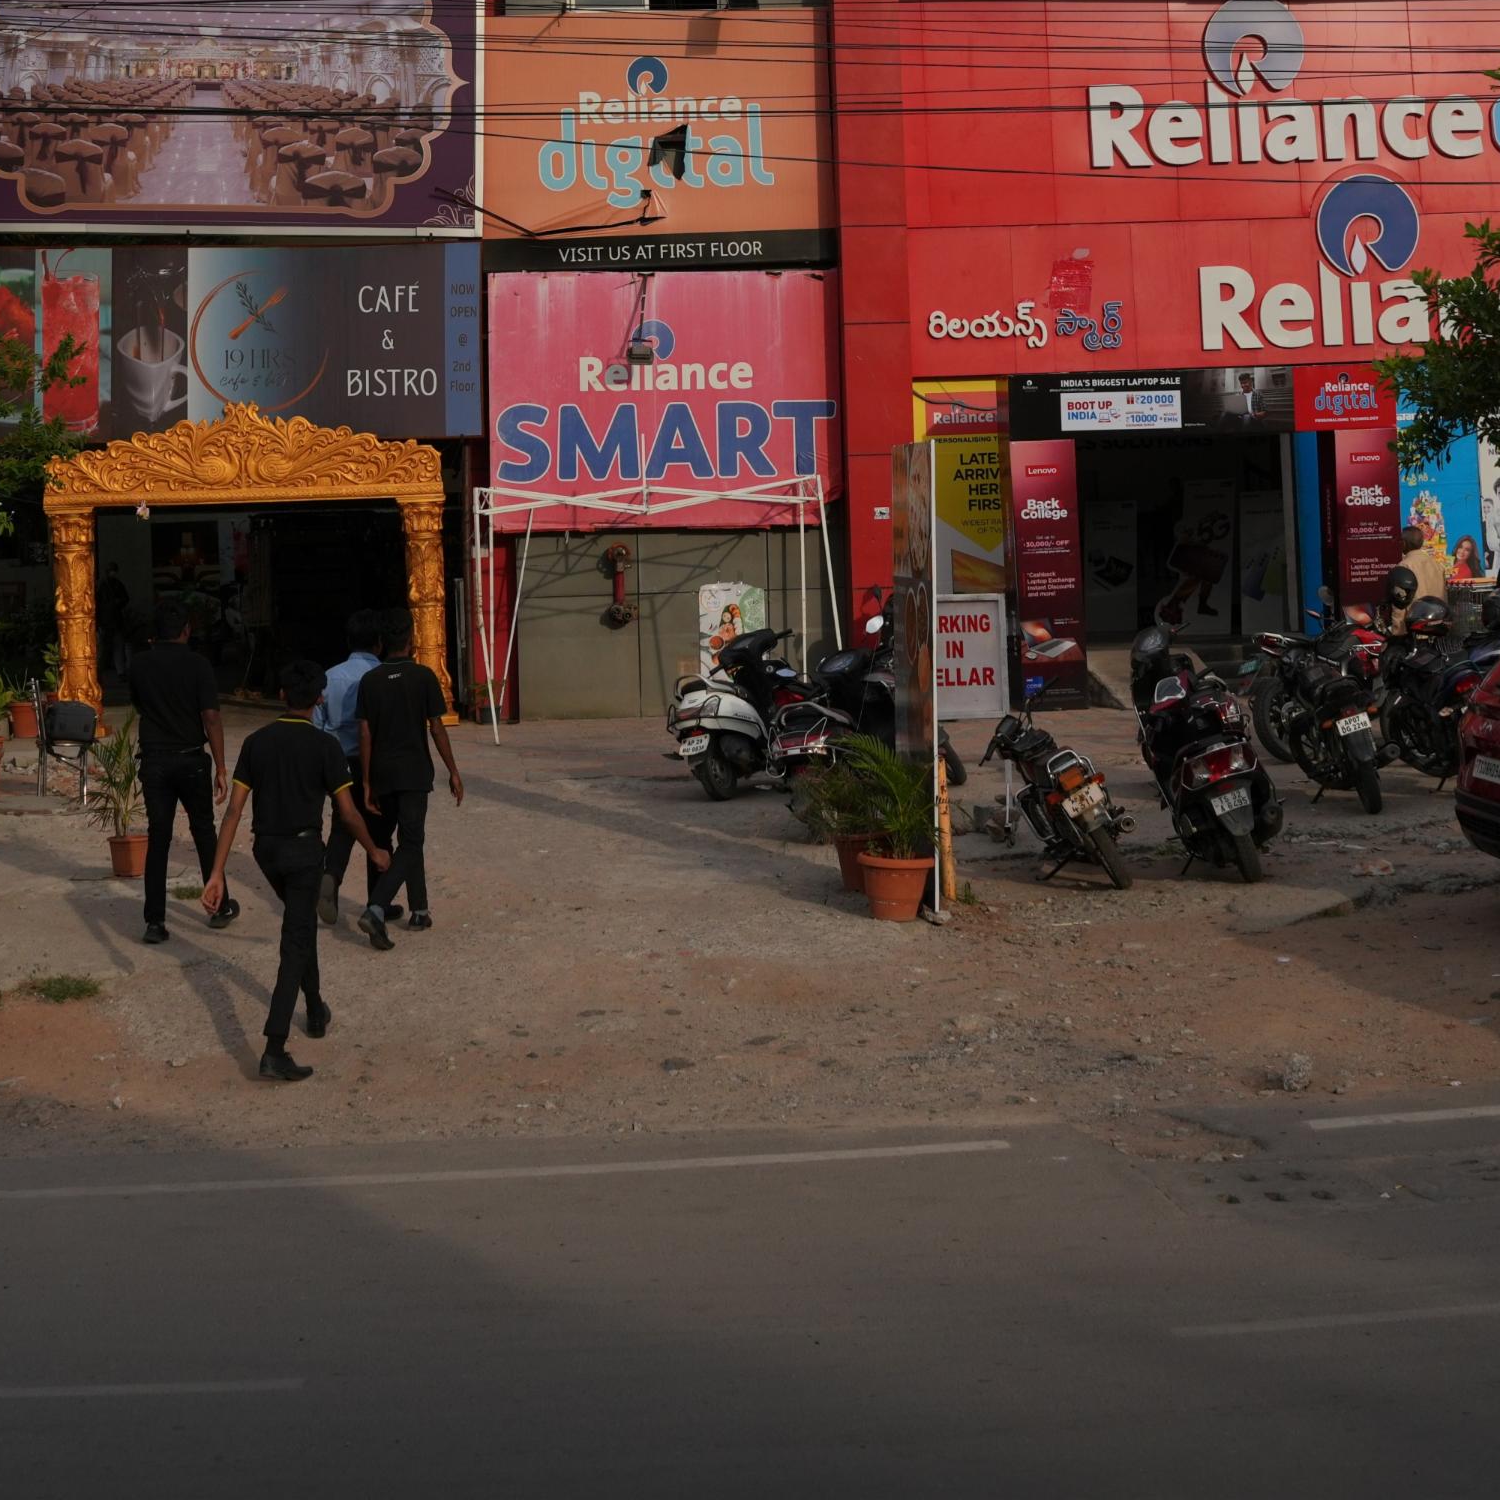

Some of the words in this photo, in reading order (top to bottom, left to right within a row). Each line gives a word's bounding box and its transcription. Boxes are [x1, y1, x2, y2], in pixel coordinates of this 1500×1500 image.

[578, 90, 744, 124] Reliance
[1086, 79, 1483, 169] Reliance
[558, 246, 604, 263] VISIT
[607, 245, 629, 261] US
[631, 244, 654, 260] AT
[660, 243, 705, 259] FIRST
[711, 240, 763, 257] FLOOR
[450, 283, 475, 295] NOW
[357, 281, 420, 313] CAFÉ
[450, 306, 478, 318] OPEN
[928, 301, 1048, 349] రిలయన్స్
[1055, 301, 1123, 351] స్మార్ట్
[381, 329, 395, 350] &
[458, 333, 468, 347] @
[225, 349, 244, 370] 19
[452, 360, 471, 373] 2nd
[578, 355, 754, 392] Reliance
[347, 367, 439, 397] BISTRO
[450, 380, 476, 393] Floor
[1060, 379, 1091, 387] INDIA'S
[1092, 378, 1126, 386] BIGGEST
[1127, 377, 1159, 386] LAPTOP
[1160, 376, 1181, 384] SALE
[1325, 382, 1370, 392] Reliance
[1067, 401, 1096, 410] BOOT
[1098, 401, 1113, 410] UP
[1315, 385, 1378, 415] digital
[933, 411, 996, 425] Reliance
[1067, 411, 1098, 420] INDIA
[496, 401, 837, 483] SMART
[1352, 454, 1381, 462] Lenovo
[1027, 467, 1058, 475] Lenovo
[1351, 485, 1383, 496] Back
[1027, 498, 1061, 510] Back
[1345, 495, 1391, 507] College
[1020, 506, 1069, 520] College
[1027, 577, 1048, 585] Laptop
[1048, 576, 1076, 584] Exchange
[937, 614, 991, 634] RKING
[946, 641, 964, 659] IN
[937, 667, 996, 687] ELLAR
